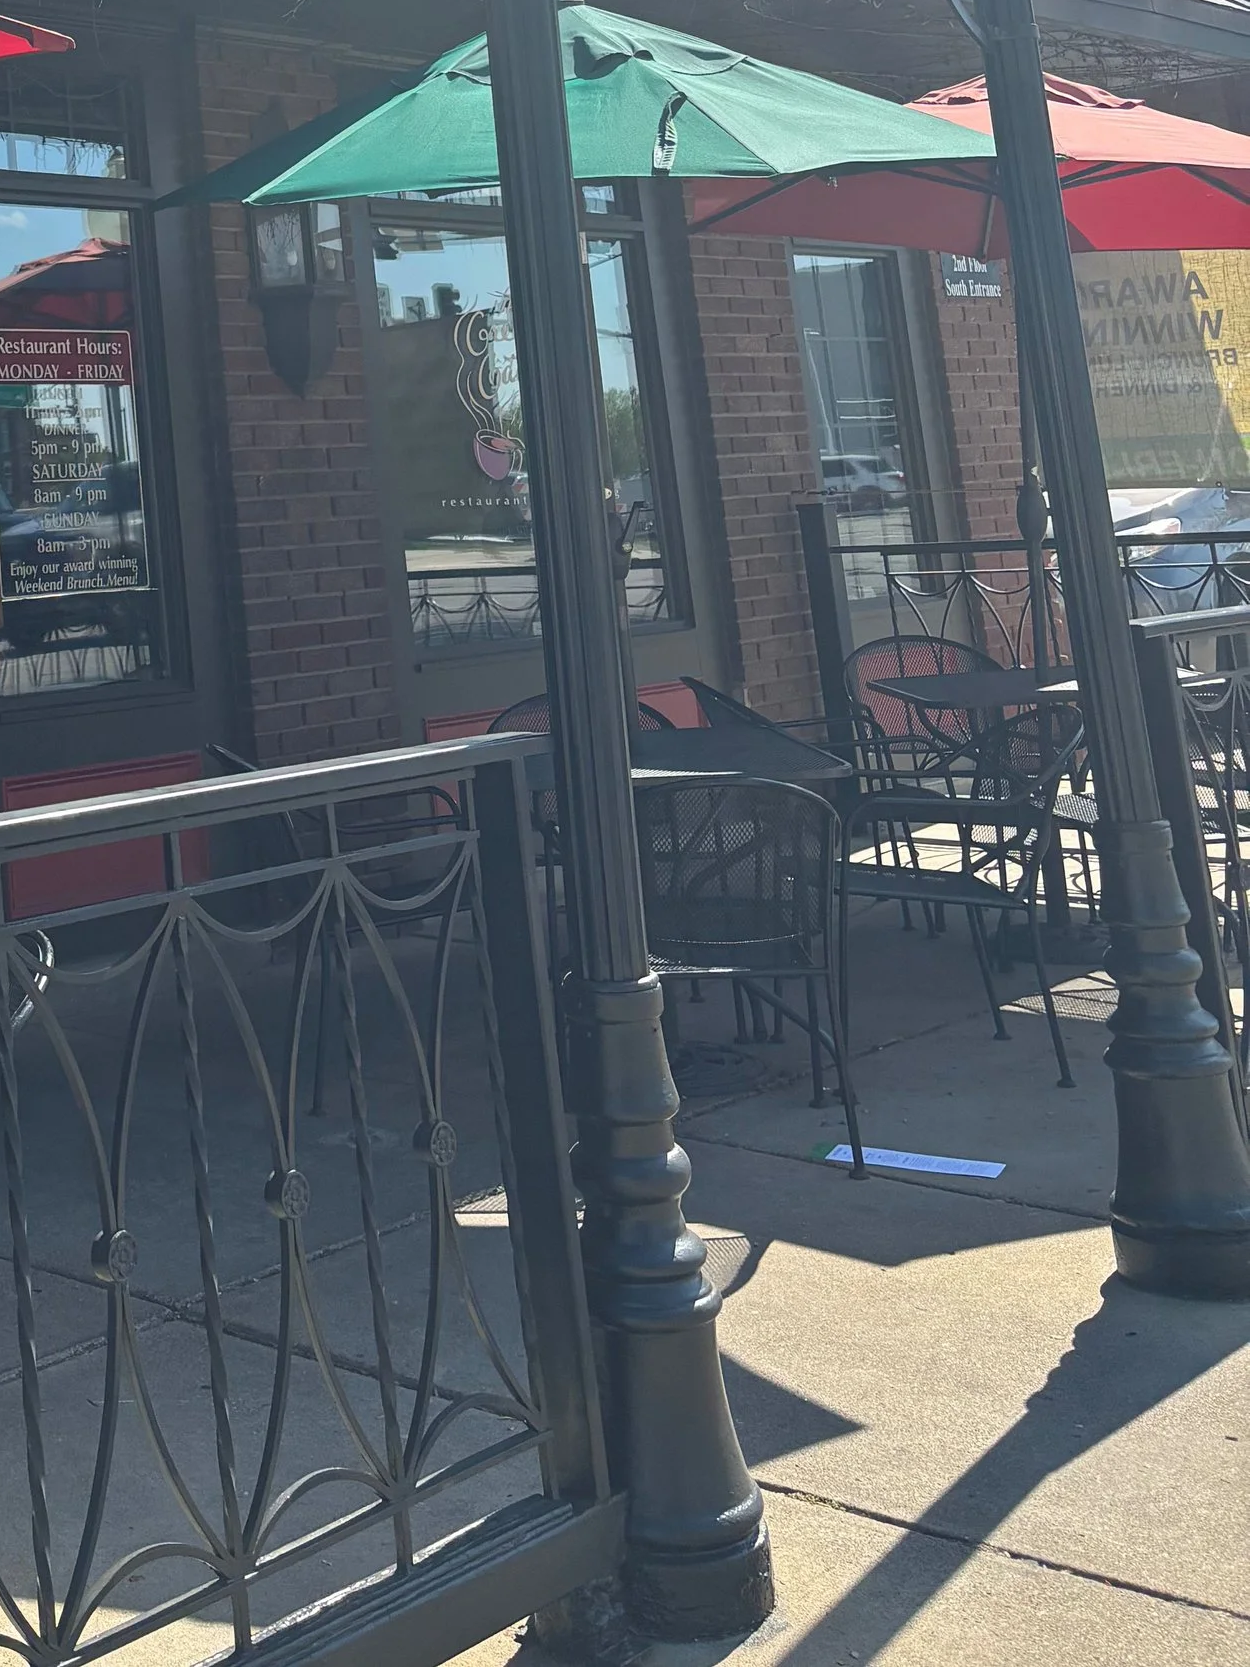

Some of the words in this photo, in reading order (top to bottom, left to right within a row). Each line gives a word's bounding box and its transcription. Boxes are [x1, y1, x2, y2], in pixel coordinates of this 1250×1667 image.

[952, 254, 967, 272] 2nd
[945, 278, 968, 297] South
[968, 279, 1002, 298] Entrance
[77, 337, 122, 355] Hours:
[78, 364, 124, 379] FRIDAY
[31, 441, 57, 459] 5pm
[72, 440, 79, 454] 9
[32, 463, 103, 480] SATURDAY
[34, 488, 61, 503] 8am
[75, 487, 82, 500] 9
[88, 489, 106, 505] pm
[441, 496, 527, 508] restaurant
[43, 512, 100, 528] SUNDAY
[37, 537, 65, 553] 8am
[92, 537, 110, 556] pm
[10, 562, 38, 579] Enjoy
[42, 563, 60, 574] our
[63, 560, 94, 573] award
[99, 555, 138, 573] winning
[14, 577, 63, 594] Weekend
[67, 574, 103, 591] Brunch
